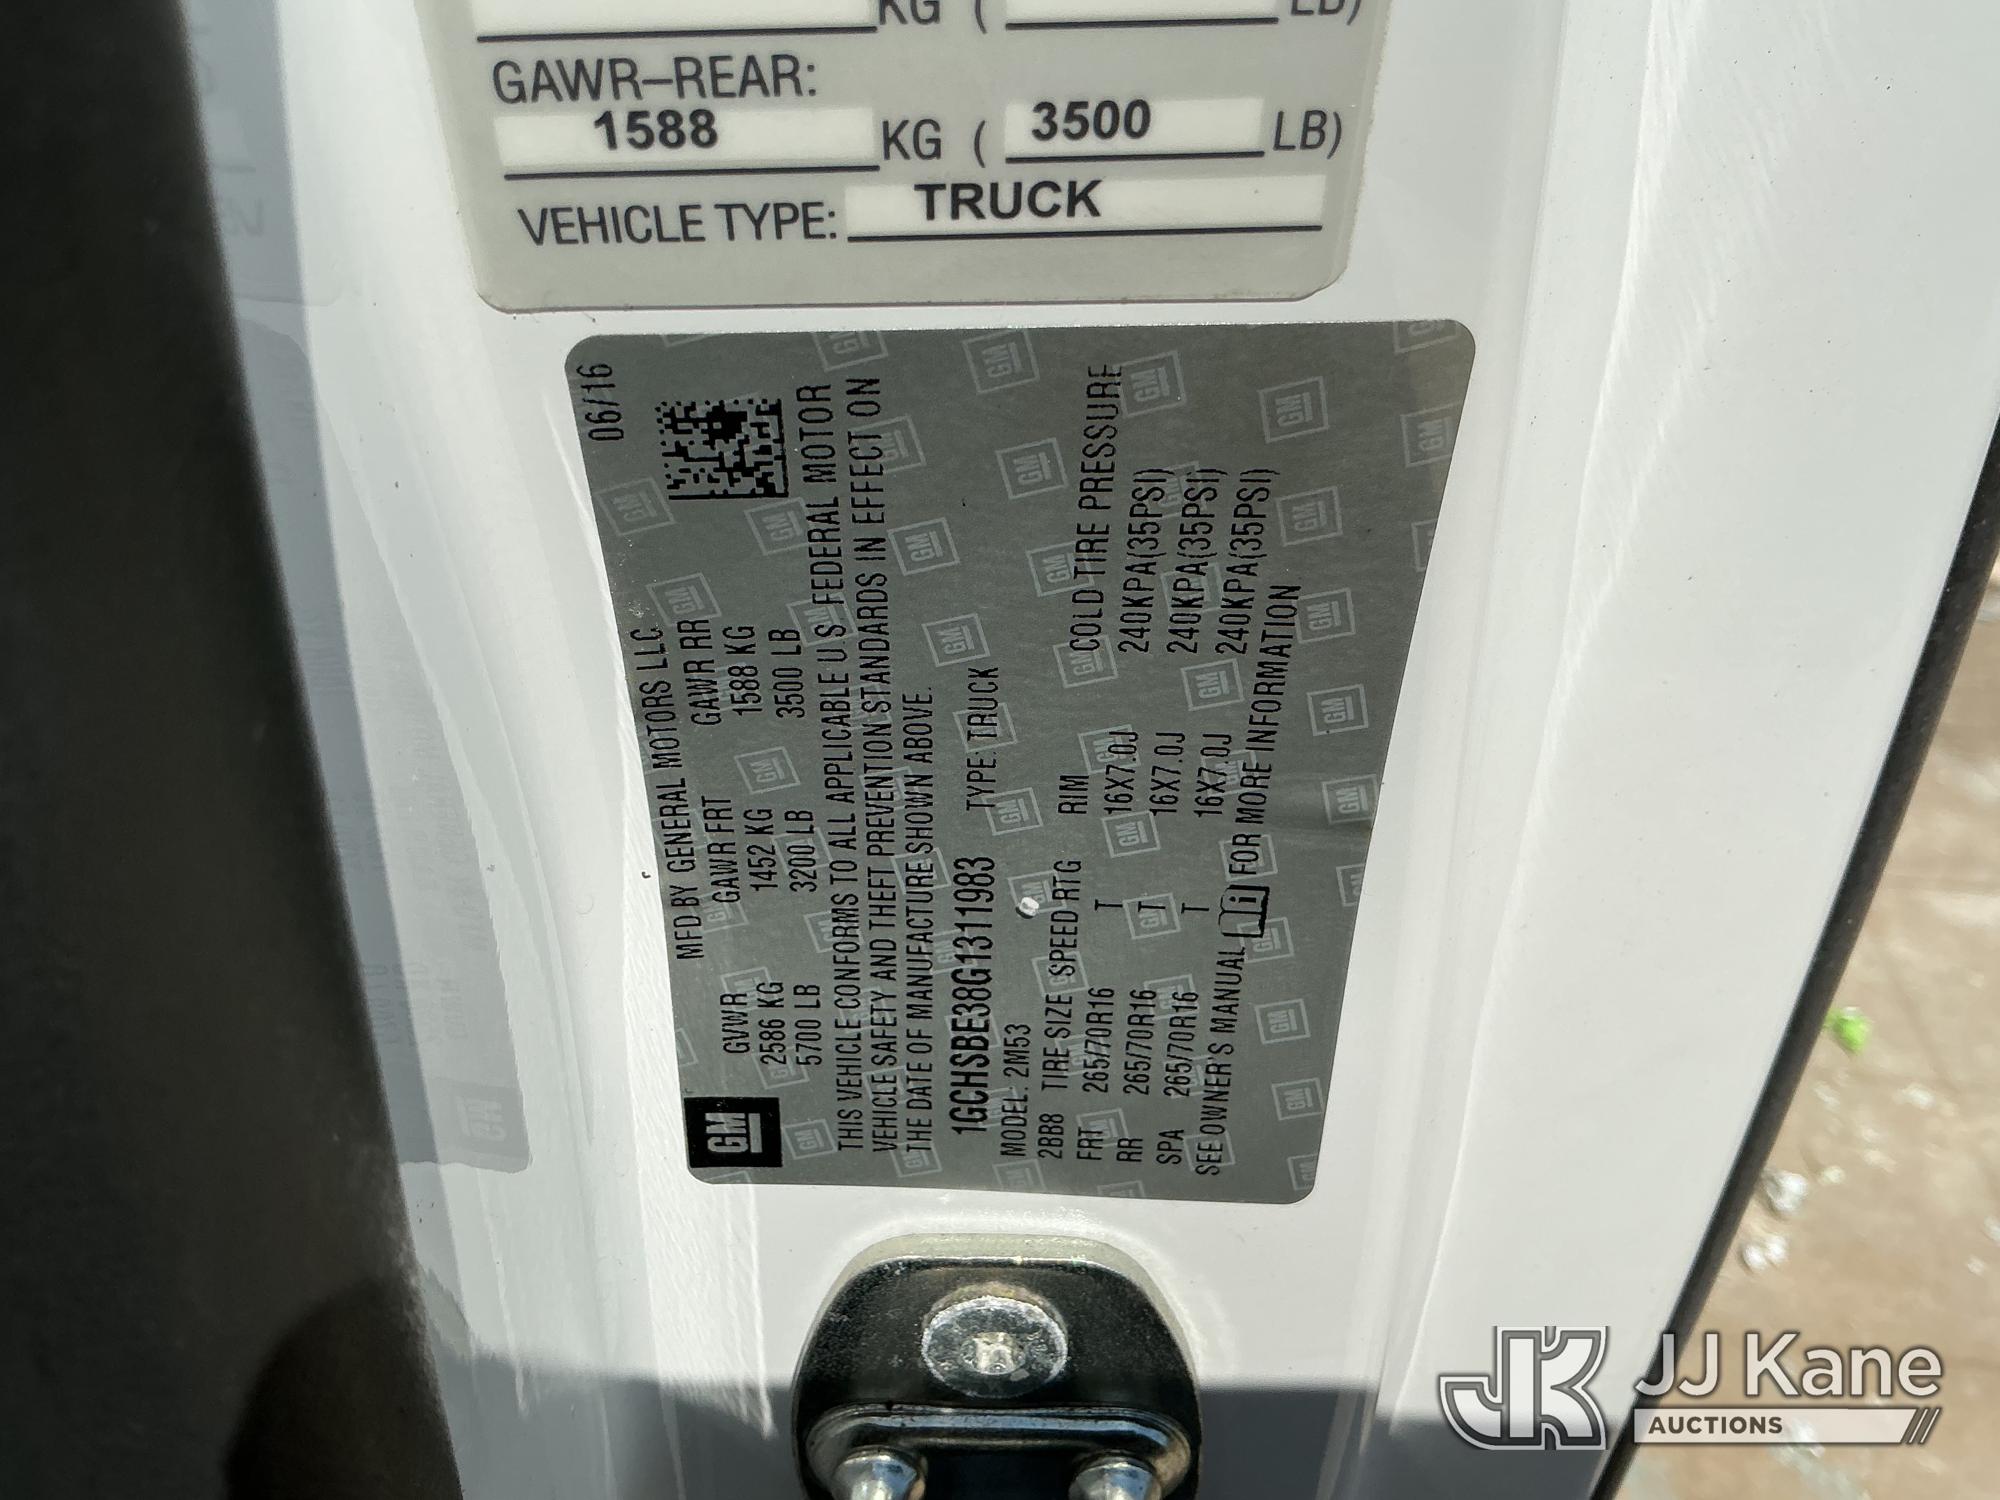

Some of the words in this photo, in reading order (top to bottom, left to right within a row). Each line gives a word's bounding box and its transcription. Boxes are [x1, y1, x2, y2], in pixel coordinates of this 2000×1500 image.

[594, 108, 718, 150] 1588
[882, 119, 942, 161] KG
[1031, 99, 1152, 142] 3500
[1272, 110, 1343, 159] LB)
[518, 204, 706, 246] VEHICLE
[714, 201, 837, 241] TYPE:
[915, 179, 1102, 221] TRUCK
[576, 364, 624, 441] 06/16
[846, 379, 880, 416] ON
[796, 385, 836, 482] MOTOR
[1078, 365, 1121, 509] PRESSURE
[848, 431, 885, 523] EFFECT
[1013, 455, 1042, 486] GM
[806, 496, 844, 604] FEDERAL
[853, 538, 886, 560] IN
[905, 533, 936, 561] GM
[1074, 523, 1109, 579] TIRE
[1118, 469, 1174, 652] 240KPA(35PSI)
[1166, 469, 1227, 653] 240KPA(35PSI)
[1215, 469, 1280, 654] 240KPA(35PSI)
[677, 620, 712, 649] RR
[722, 627, 756, 654] KG
[936, 627, 967, 654] GM
[1070, 590, 1104, 651] COLD
[1305, 602, 1334, 631] GM
[630, 628, 668, 670] LLC
[768, 630, 801, 655] LB
[855, 573, 891, 712] STANDARDS
[683, 660, 721, 725] GAWR
[728, 666, 762, 716] 1588
[772, 668, 805, 718] 3500
[1194, 672, 1222, 698] GM
[1245, 586, 1301, 751] INFORMATION
[638, 681, 682, 768] MOTORS
[902, 688, 933, 763] ABOVE.
[967, 668, 998, 741] TRUCK
[1320, 697, 1347, 724] GM
[818, 673, 854, 804] APPLICABLE
[862, 724, 895, 856] PREVENTION
[966, 752, 996, 811] TYPE:
[1058, 775, 1089, 814] RIM
[1104, 732, 1138, 814] 16X7.0J
[1149, 733, 1185, 816] 16X7.0J
[1194, 734, 1232, 817] 16X7.0J
[1235, 762, 1272, 824] MORE
[654, 778, 696, 872] GENERAL
[701, 796, 734, 832] FRT
[743, 809, 773, 835] KG
[784, 811, 814, 834] LB
[827, 813, 856, 850] ALL
[904, 775, 933, 854] SHOWN
[996, 799, 1023, 824] GM
[1114, 821, 1141, 847] GM
[707, 842, 740, 903] GAWR
[747, 845, 778, 891] 1452
[787, 845, 817, 892] 3200
[829, 860, 858, 885] TO
[1229, 834, 1261, 874] FOR
[669, 885, 700, 907] BY
[868, 867, 896, 930] THEFT
[1052, 861, 1081, 900] RTG
[1095, 899, 1123, 911] T
[1138, 901, 1166, 912] T
[1181, 903, 1209, 914] T
[673, 916, 704, 959] MFD
[831, 894, 861, 1009] CONFORMS
[869, 939, 897, 981] AND
[905, 863, 933, 1019] MANUFACTURE
[1049, 911, 1078, 976] SPEED
[756, 982, 784, 1008] KG
[793, 985, 821, 1008] LB
[949, 857, 995, 1134] 1GCHSBE38G1311983
[1210, 947, 1245, 1033] MANUAL
[720, 993, 750, 1053] GVWR
[870, 991, 897, 1066] SAFETY
[1044, 994, 1072, 1038] SIZE
[1082, 988, 1114, 1093] 265/70R16
[758, 1019, 786, 1064] 2586
[795, 1020, 822, 1065] 5700
[835, 1019, 862, 1101] VEHICLE
[906, 1029, 932, 1054] OF
[1003, 1024, 1031, 1077] 2M53
[1123, 990, 1157, 1095] 265/70R16
[1163, 992, 1199, 1096] 265/70R16
[906, 1062, 932, 1110] DATE
[1041, 1047, 1070, 1091] TIRE
[1200, 1043, 1234, 1135] OWNER'S
[705, 1112, 750, 1153] GM
[837, 1109, 863, 1151] THIS
[871, 1075, 897, 1152] VEHICLE
[906, 1118, 932, 1152] THE
[1077, 1127, 1103, 1160] FRT
[1116, 1138, 1143, 1162] RR
[1156, 1130, 1184, 1164] SPA
[1195, 1143, 1223, 1175] SEE
